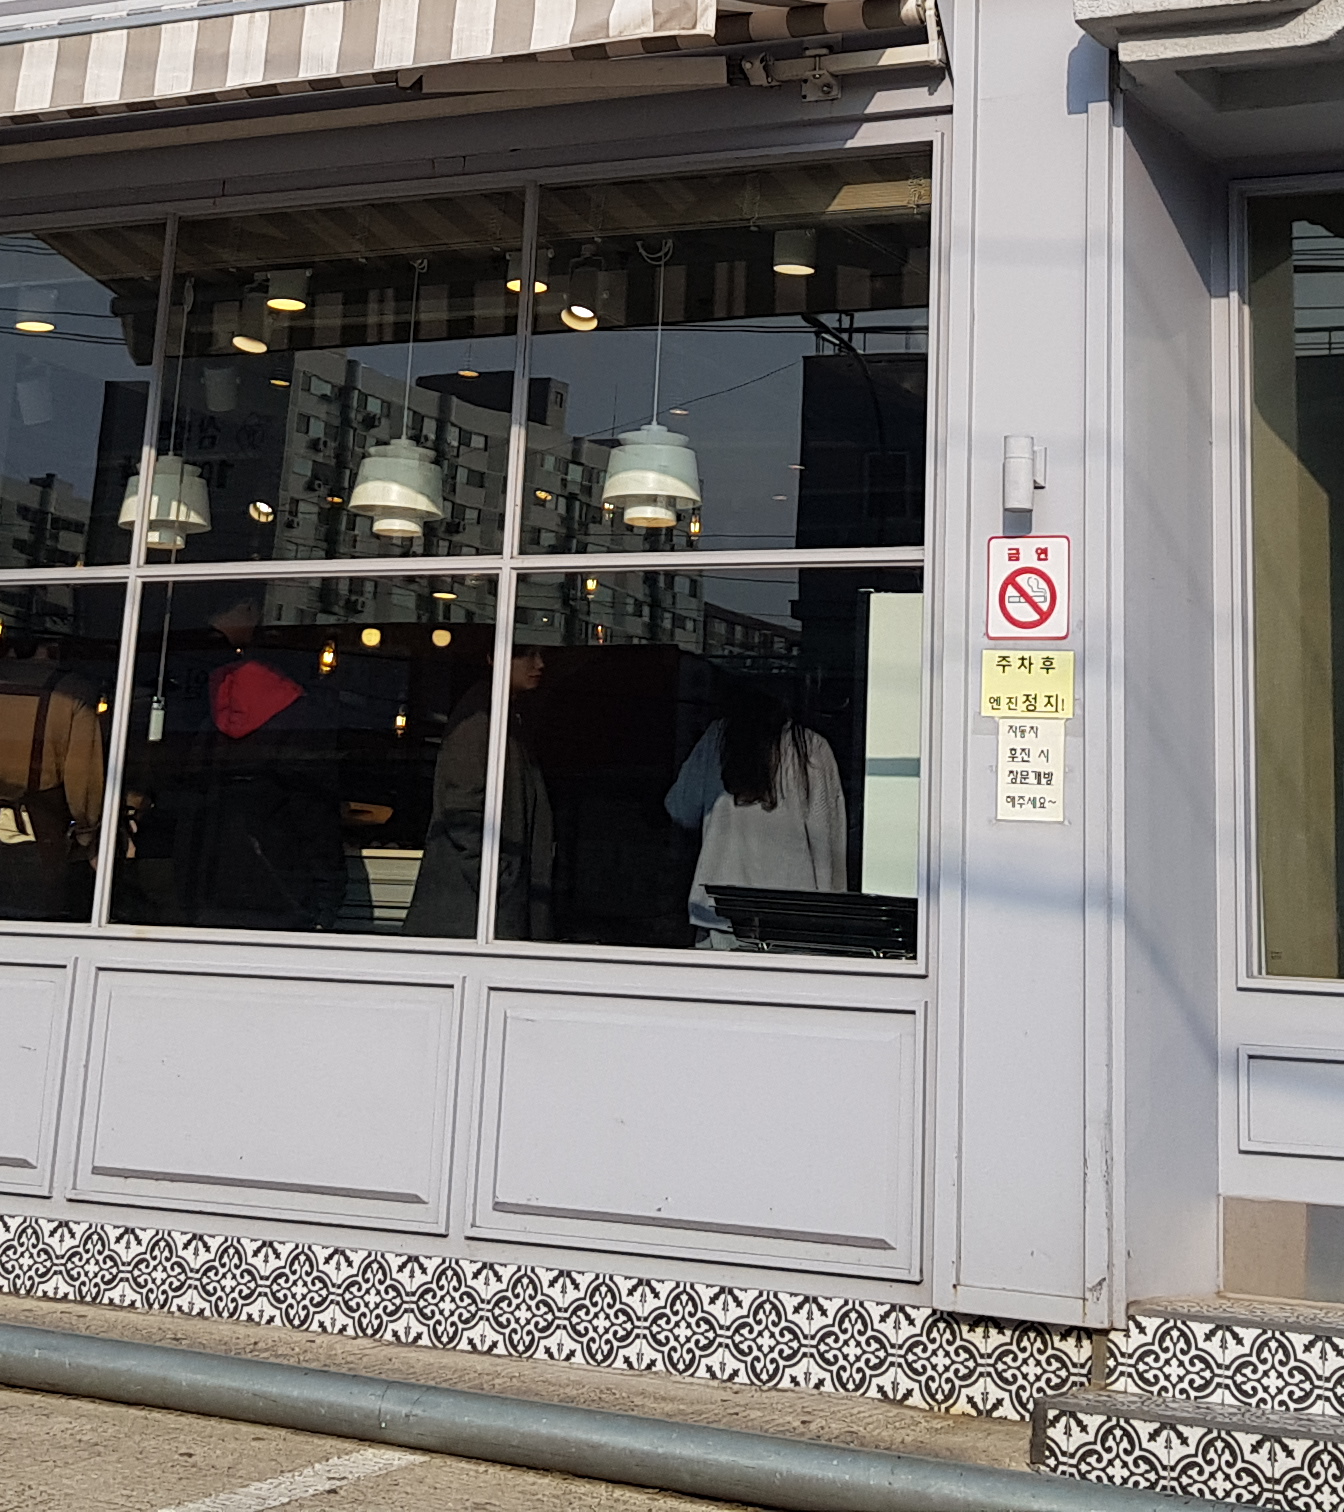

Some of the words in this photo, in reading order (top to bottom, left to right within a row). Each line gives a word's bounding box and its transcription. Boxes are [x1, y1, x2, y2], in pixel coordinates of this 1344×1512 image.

[1007, 547, 1049, 562] 금연
[1007, 725, 1038, 738] 자동차
[1007, 748, 1031, 762] 후진
[1038, 749, 1049, 763] 시
